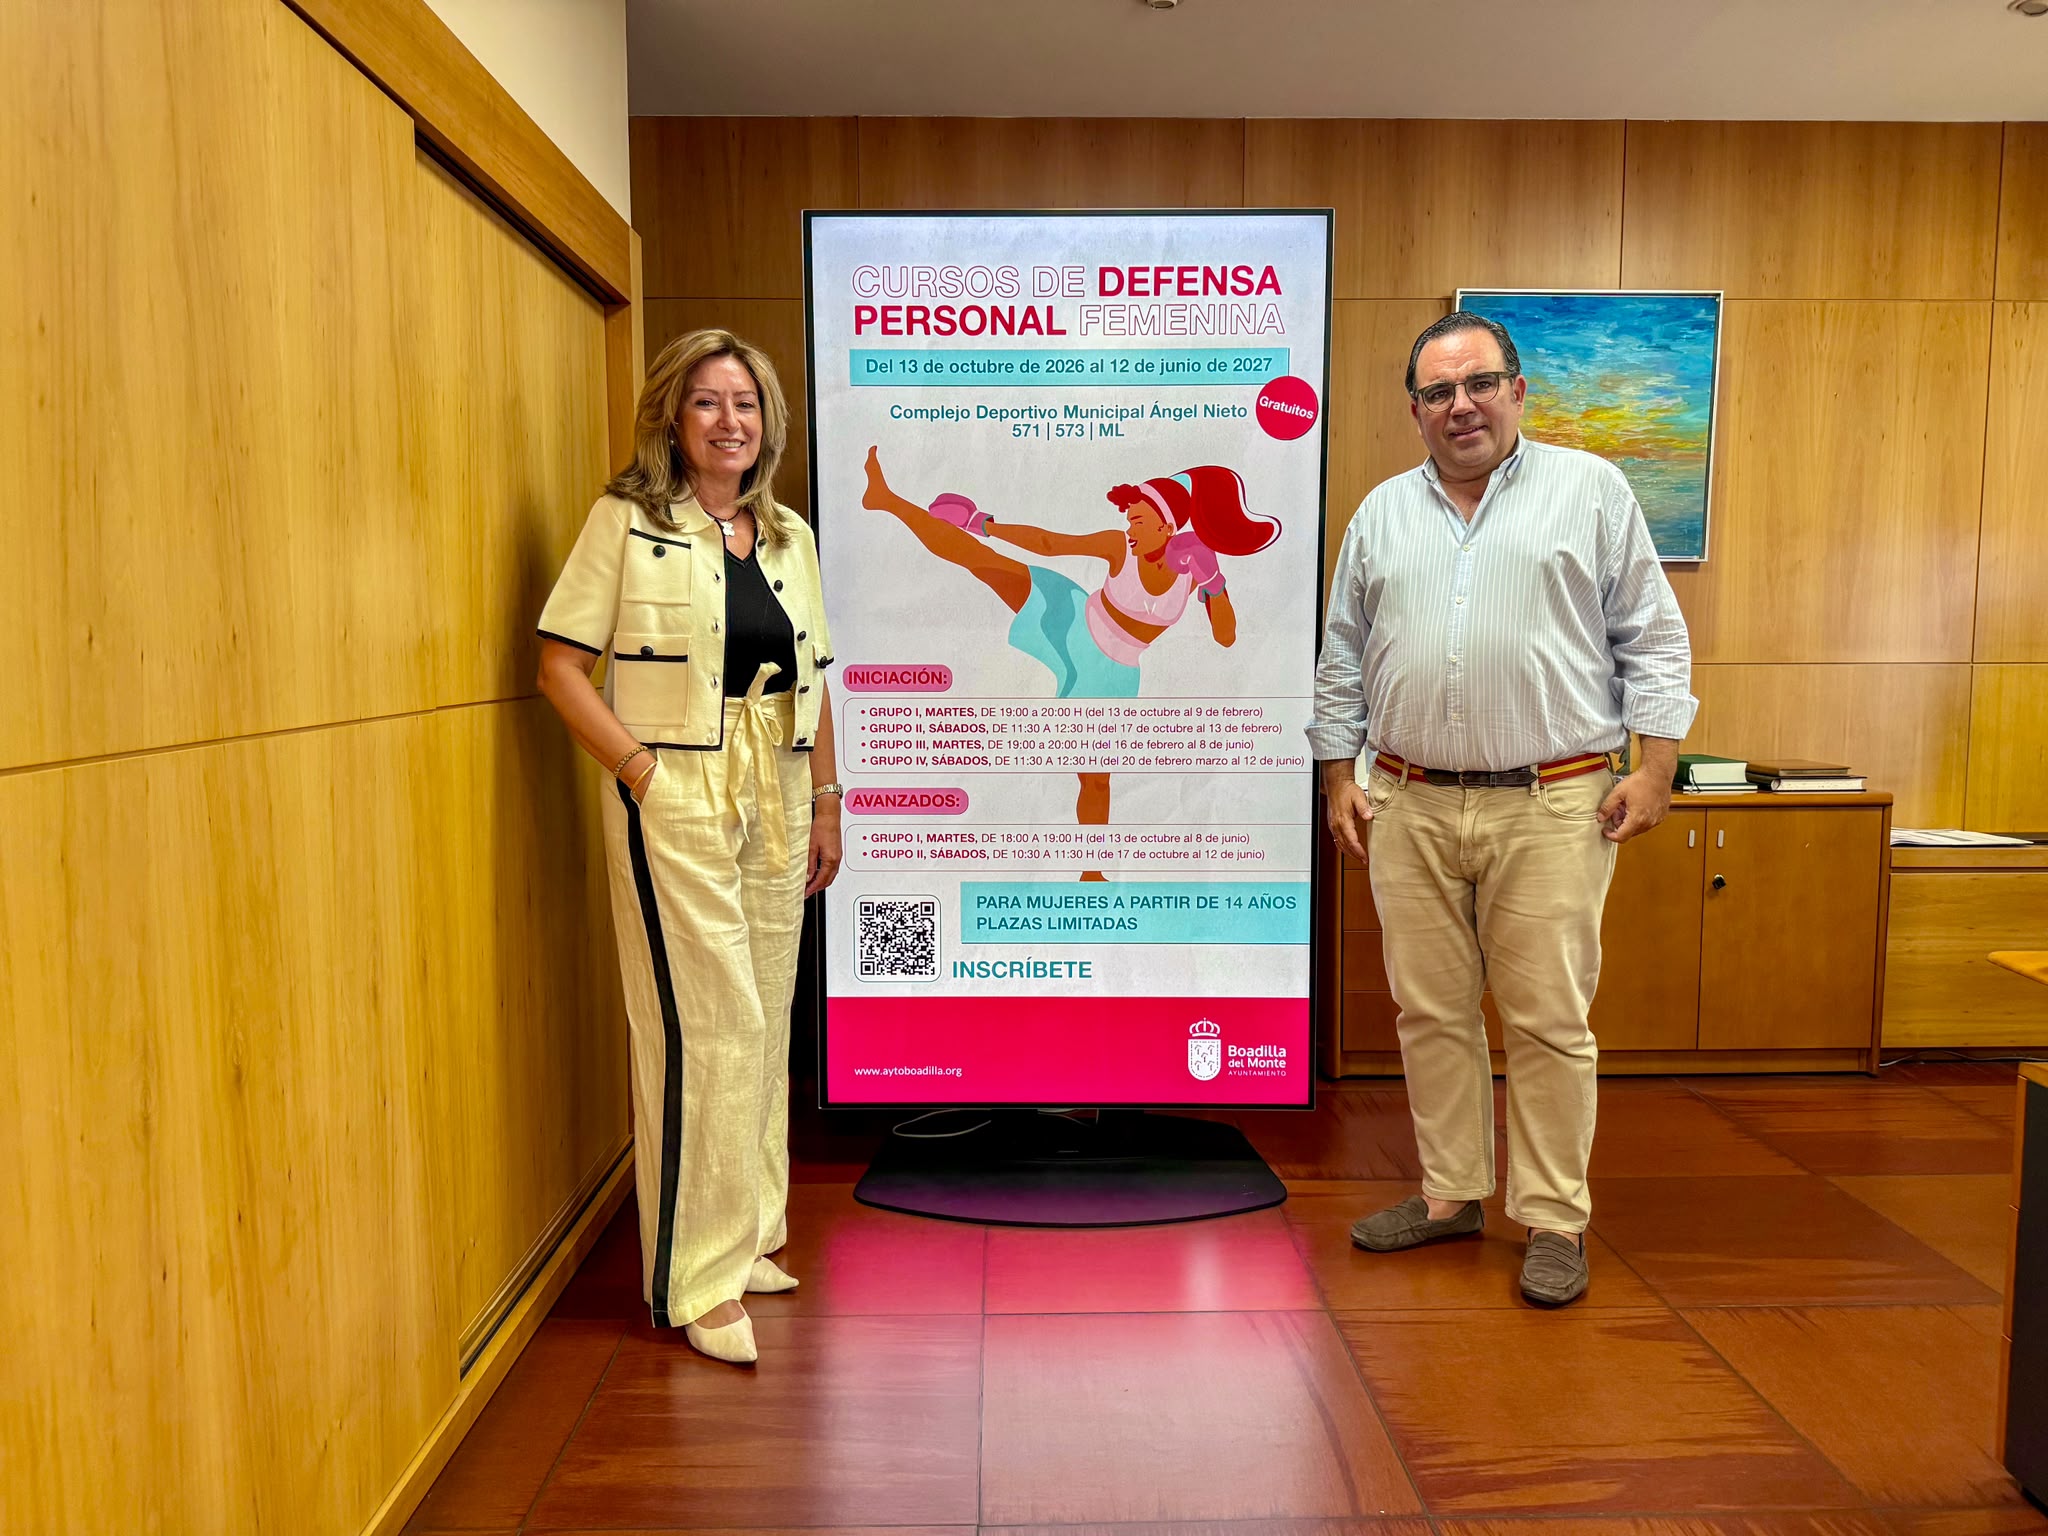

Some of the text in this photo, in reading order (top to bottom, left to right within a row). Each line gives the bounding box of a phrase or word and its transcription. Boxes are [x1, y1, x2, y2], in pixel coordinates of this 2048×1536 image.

[853, 265, 1282, 298] CURSOS DE DEFENSA
[855, 304, 1285, 336] PERSONAL FEMENINA
[866, 358, 1272, 375] Del 13 de octubre de 2026 al 12 de junio de 2027
[890, 401, 1247, 423] Complejo Deportivo Municipal Ángel Nieto
[1259, 396, 1314, 419] Gratuitos
[1012, 424, 1039, 437] 571
[1056, 424, 1084, 437] 573
[1099, 423, 1124, 437] ML
[848, 668, 948, 685] INICIACIÓN:
[870, 707, 912, 716] GRUPO
[916, 708, 921, 718] I,
[926, 707, 977, 718] MARTES,
[981, 708, 996, 716] DE
[1000, 708, 1028, 716] 19:00
[1041, 708, 1070, 717] 20:00
[1074, 708, 1082, 716] H
[1086, 708, 1104, 718] (del
[1108, 708, 1120, 716] 13
[1124, 708, 1137, 716] de
[1140, 707, 1180, 716] octubre
[1184, 707, 1192, 716] al
[1196, 707, 1202, 716] 9
[1206, 707, 1219, 716] de
[1223, 707, 1262, 718] febrero)
[870, 721, 1282, 735] GRUPO II, SÁBADOS, DE 11:30 A 12:30 H (del 17 de octubre al 13 de febrero)
[870, 740, 912, 749] GRUPO
[916, 740, 929, 751] III,
[933, 740, 984, 751] MARTES,
[988, 740, 1003, 749] DE
[1007, 740, 1035, 749] 19:00
[1048, 740, 1077, 749] 20:00
[1081, 740, 1088, 749] H
[1092, 740, 1110, 751] (del
[1115, 740, 1127, 749] 16
[1130, 740, 1143, 749] de
[1147, 740, 1184, 749] febrero
[1188, 740, 1196, 749] al
[1200, 740, 1206, 749] 8
[1209, 740, 1222, 749] de
[1226, 740, 1253, 751] junio)
[870, 756, 912, 765] GRUPO
[916, 756, 928, 767] IV,
[932, 754, 991, 767] SÁBADOS,
[995, 756, 1010, 765] DE
[1014, 756, 1042, 765] 11:30
[1046, 756, 1053, 765] A
[1057, 756, 1085, 765] 12:30
[1089, 756, 1096, 765] H
[1100, 756, 1118, 767] (del
[1122, 756, 1135, 765] 20
[1139, 756, 1151, 765] de
[1155, 756, 1192, 765] febrero
[1232, 756, 1240, 765] al
[1244, 756, 1256, 765] 12
[1260, 756, 1273, 765] de
[1276, 756, 1304, 767] junio)
[853, 794, 960, 809] AVANZADOS:
[871, 833, 1249, 845] GRUPO I, MARTES, DE 18:00 A 19:00 H (del 13 de octubre al 8 de junio)
[871, 847, 1264, 861] GRUPO II, SÁBADOS, DE 10:30 A 11:30 H (de 17 de octubre al 12 de junio)
[977, 893, 1296, 909] PARA MUJERES A PARTIR DE 14 AÑOS
[977, 917, 1137, 930] PLAZAS LIMITADAS
[953, 957, 1092, 978] INSCRÍBETE
[1228, 1045, 1286, 1057] Boadilla
[1228, 1058, 1286, 1068] del Monte
[855, 1066, 962, 1077] www.aytoboadilla.org
